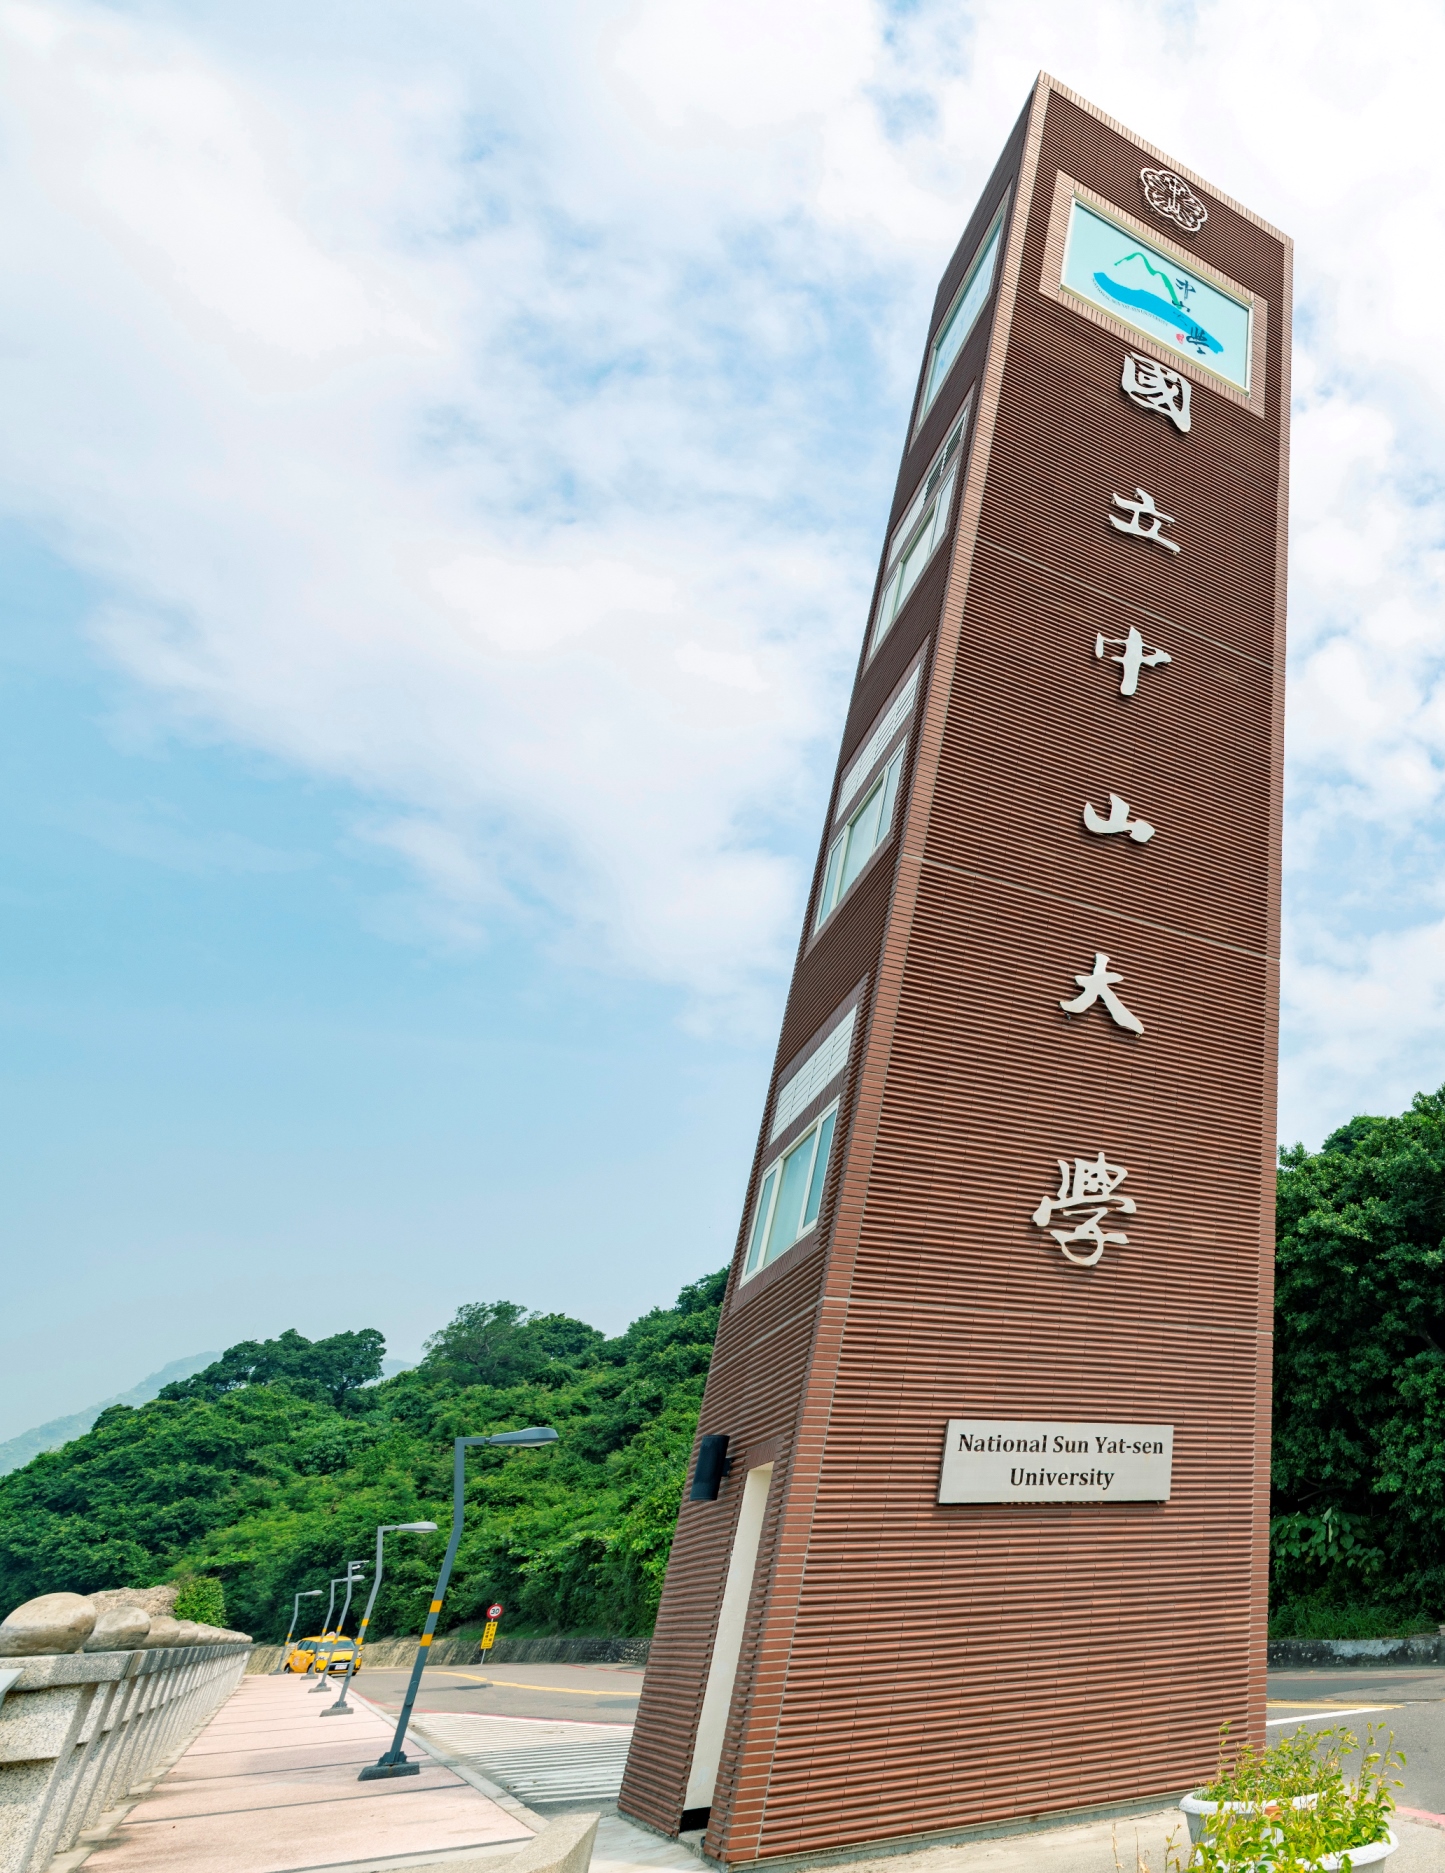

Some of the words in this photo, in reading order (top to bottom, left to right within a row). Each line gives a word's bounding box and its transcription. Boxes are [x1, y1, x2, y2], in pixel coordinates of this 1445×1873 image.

[1031, 351, 1192, 1267] 國立中山大學
[958, 1433, 1047, 1453] National
[1052, 1435, 1089, 1454] Sun
[1095, 1436, 1164, 1455] Yat-sen
[1010, 1467, 1115, 1490] University
